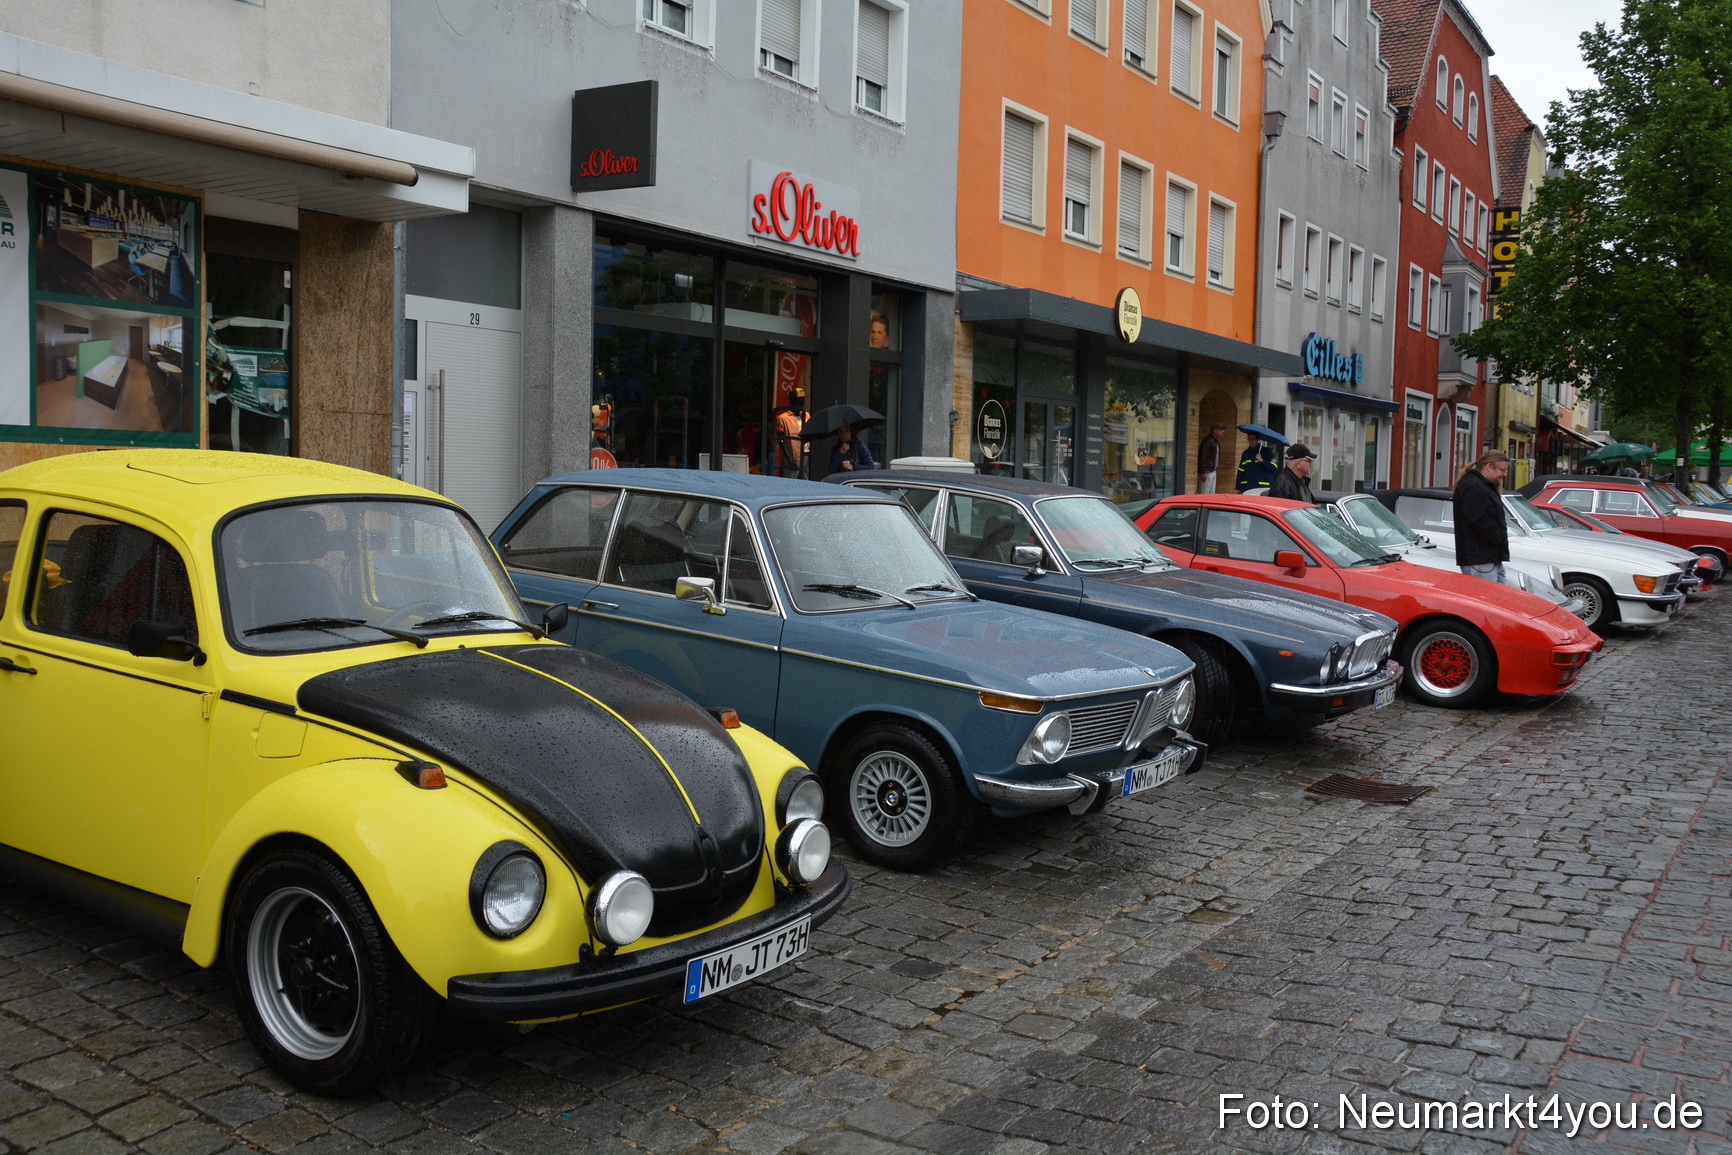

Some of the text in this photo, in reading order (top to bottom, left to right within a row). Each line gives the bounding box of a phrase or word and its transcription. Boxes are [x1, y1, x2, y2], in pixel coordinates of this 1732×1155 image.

[580, 149, 639, 177] s.Oliver
[752, 171, 860, 257] s.Oliver
[0, 241, 16, 249] AU
[1124, 300, 1138, 315] Dianas
[470, 313, 480, 325] 29
[1304, 331, 1353, 383] Eilles
[984, 414, 1001, 428] Dianas
[983, 427, 1001, 440] Floristik
[1131, 768, 1148, 791] NM
[690, 985, 696, 994] D
[701, 954, 732, 993] NM
